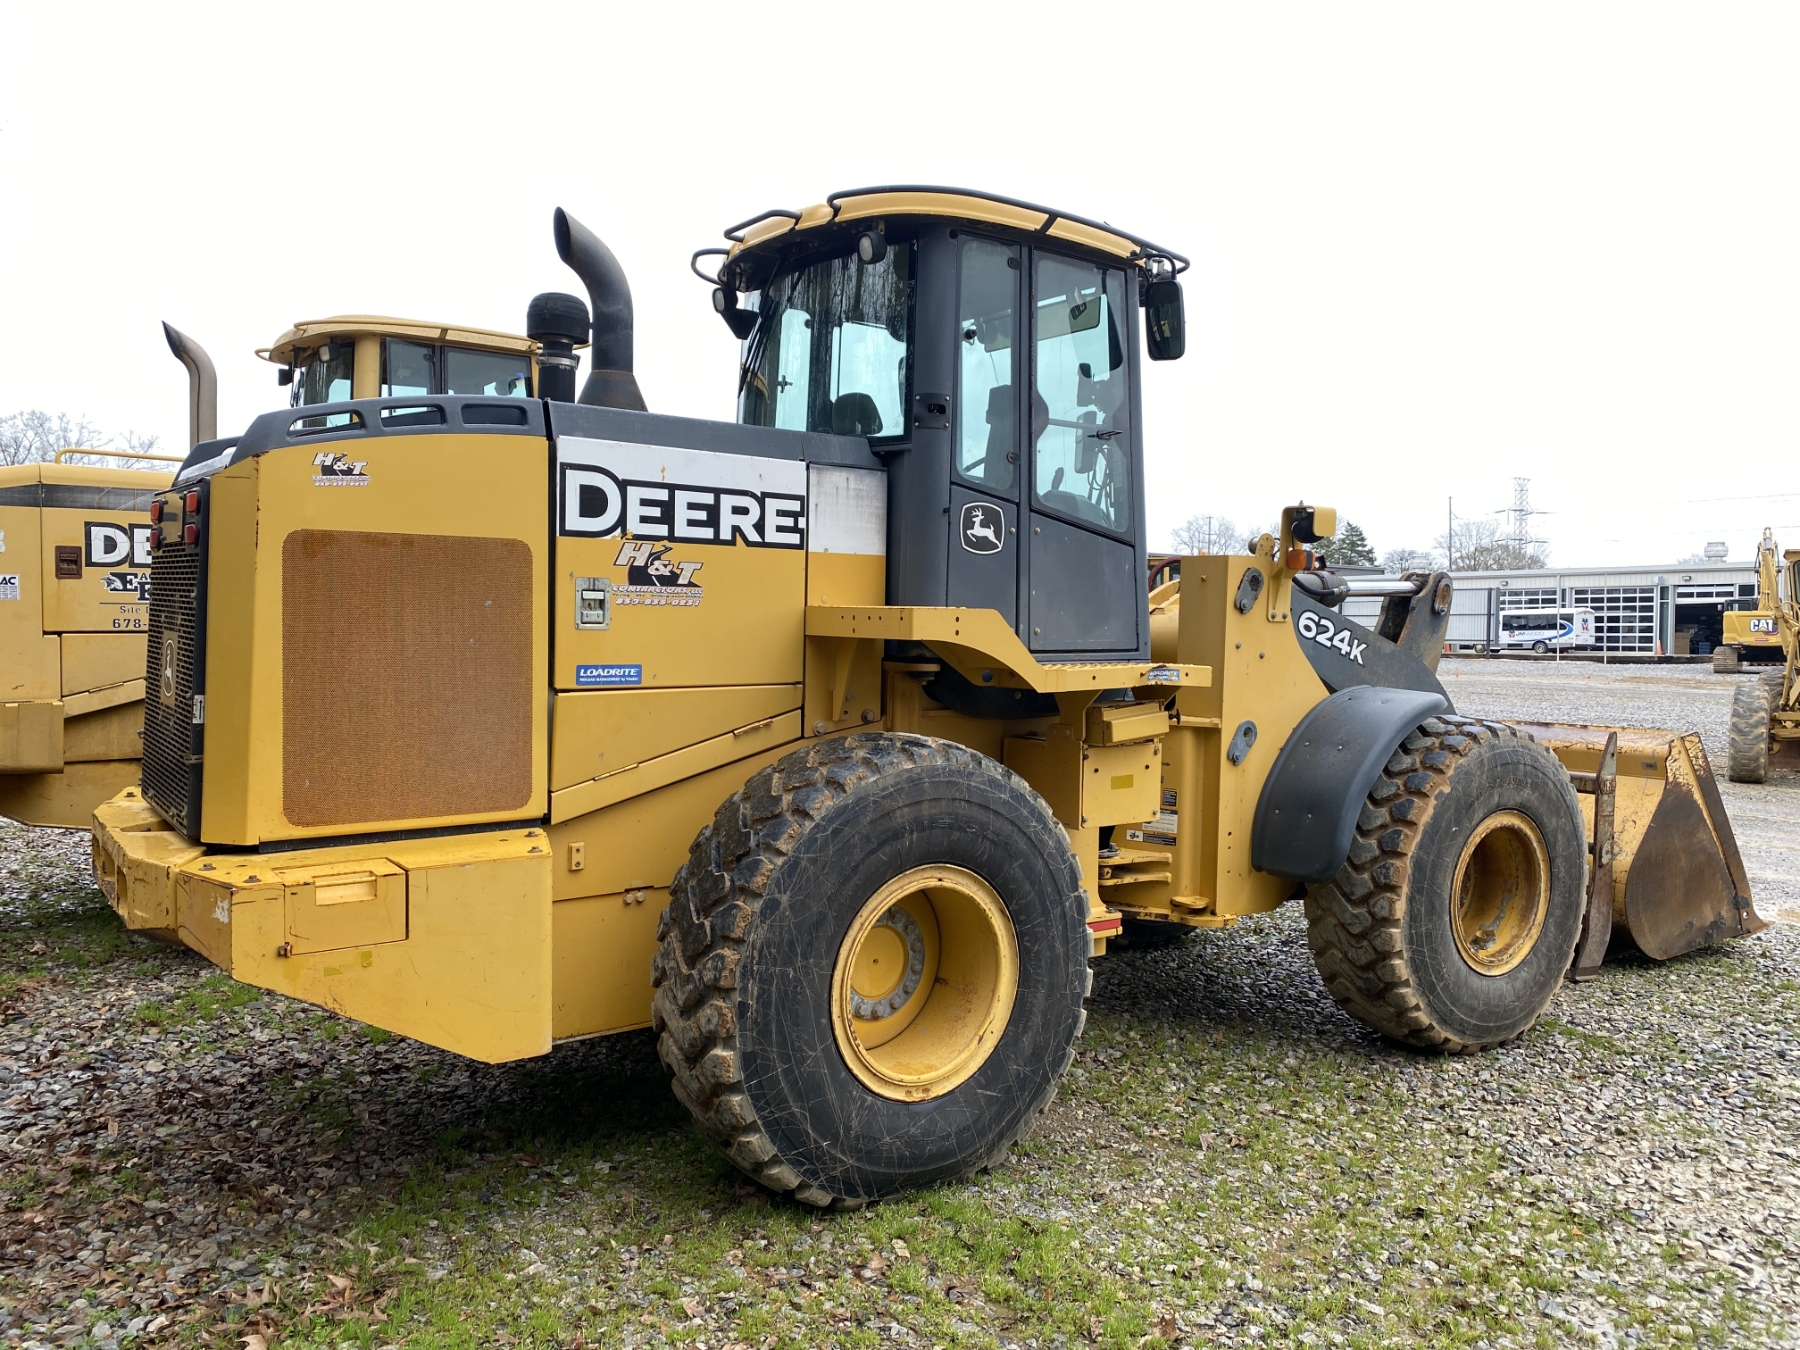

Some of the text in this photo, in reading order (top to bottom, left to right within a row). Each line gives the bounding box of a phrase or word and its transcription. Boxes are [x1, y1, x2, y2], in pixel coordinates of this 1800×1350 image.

[312, 453, 368, 475] H&T
[562, 465, 804, 547] DEERE
[613, 542, 703, 585] H&T
[1298, 610, 1369, 668] 624K
[1750, 619, 1773, 632] CAT
[580, 668, 640, 676] LOADRITE
